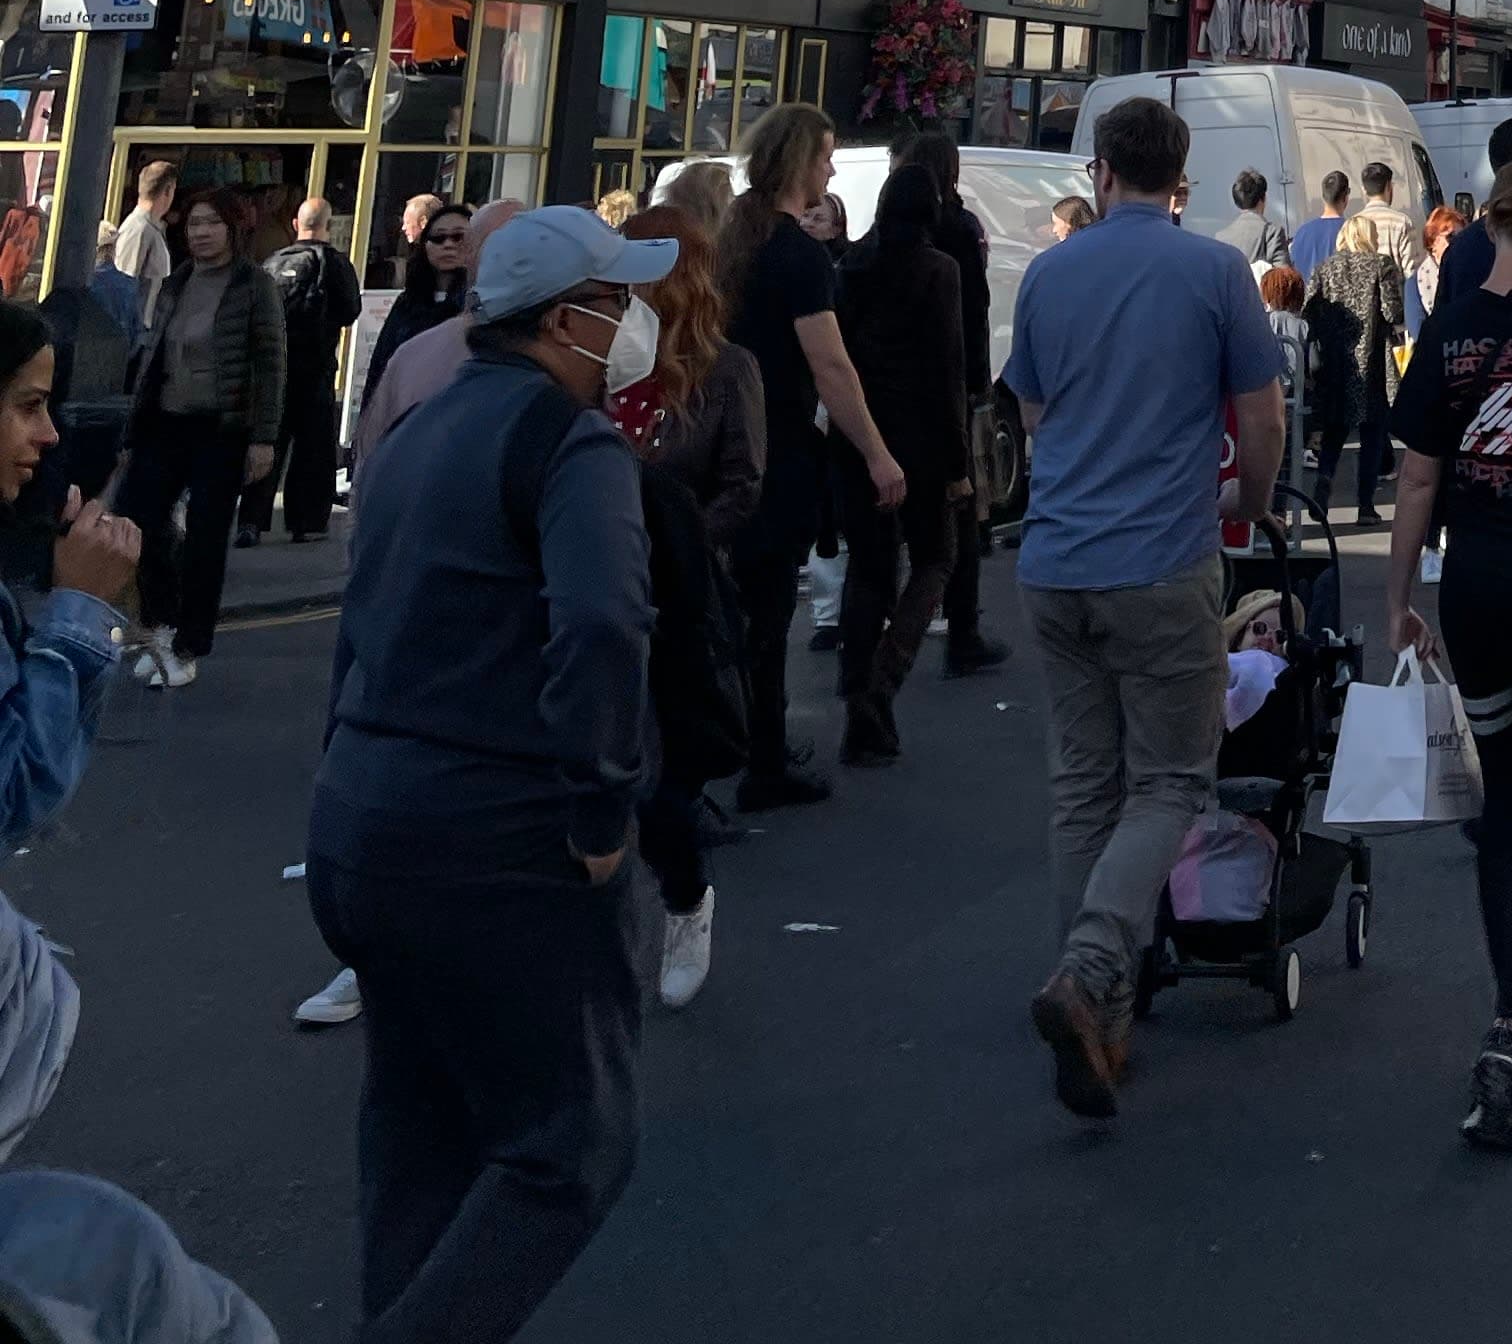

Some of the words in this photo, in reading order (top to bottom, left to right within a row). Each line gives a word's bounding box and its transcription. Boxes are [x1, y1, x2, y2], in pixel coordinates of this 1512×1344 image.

[46, 12, 71, 25] and
[76, 11, 98, 24] for
[102, 12, 150, 24] access
[1342, 23, 1365, 51] one
[1367, 22, 1380, 59] of
[1389, 25, 1411, 58] kind
